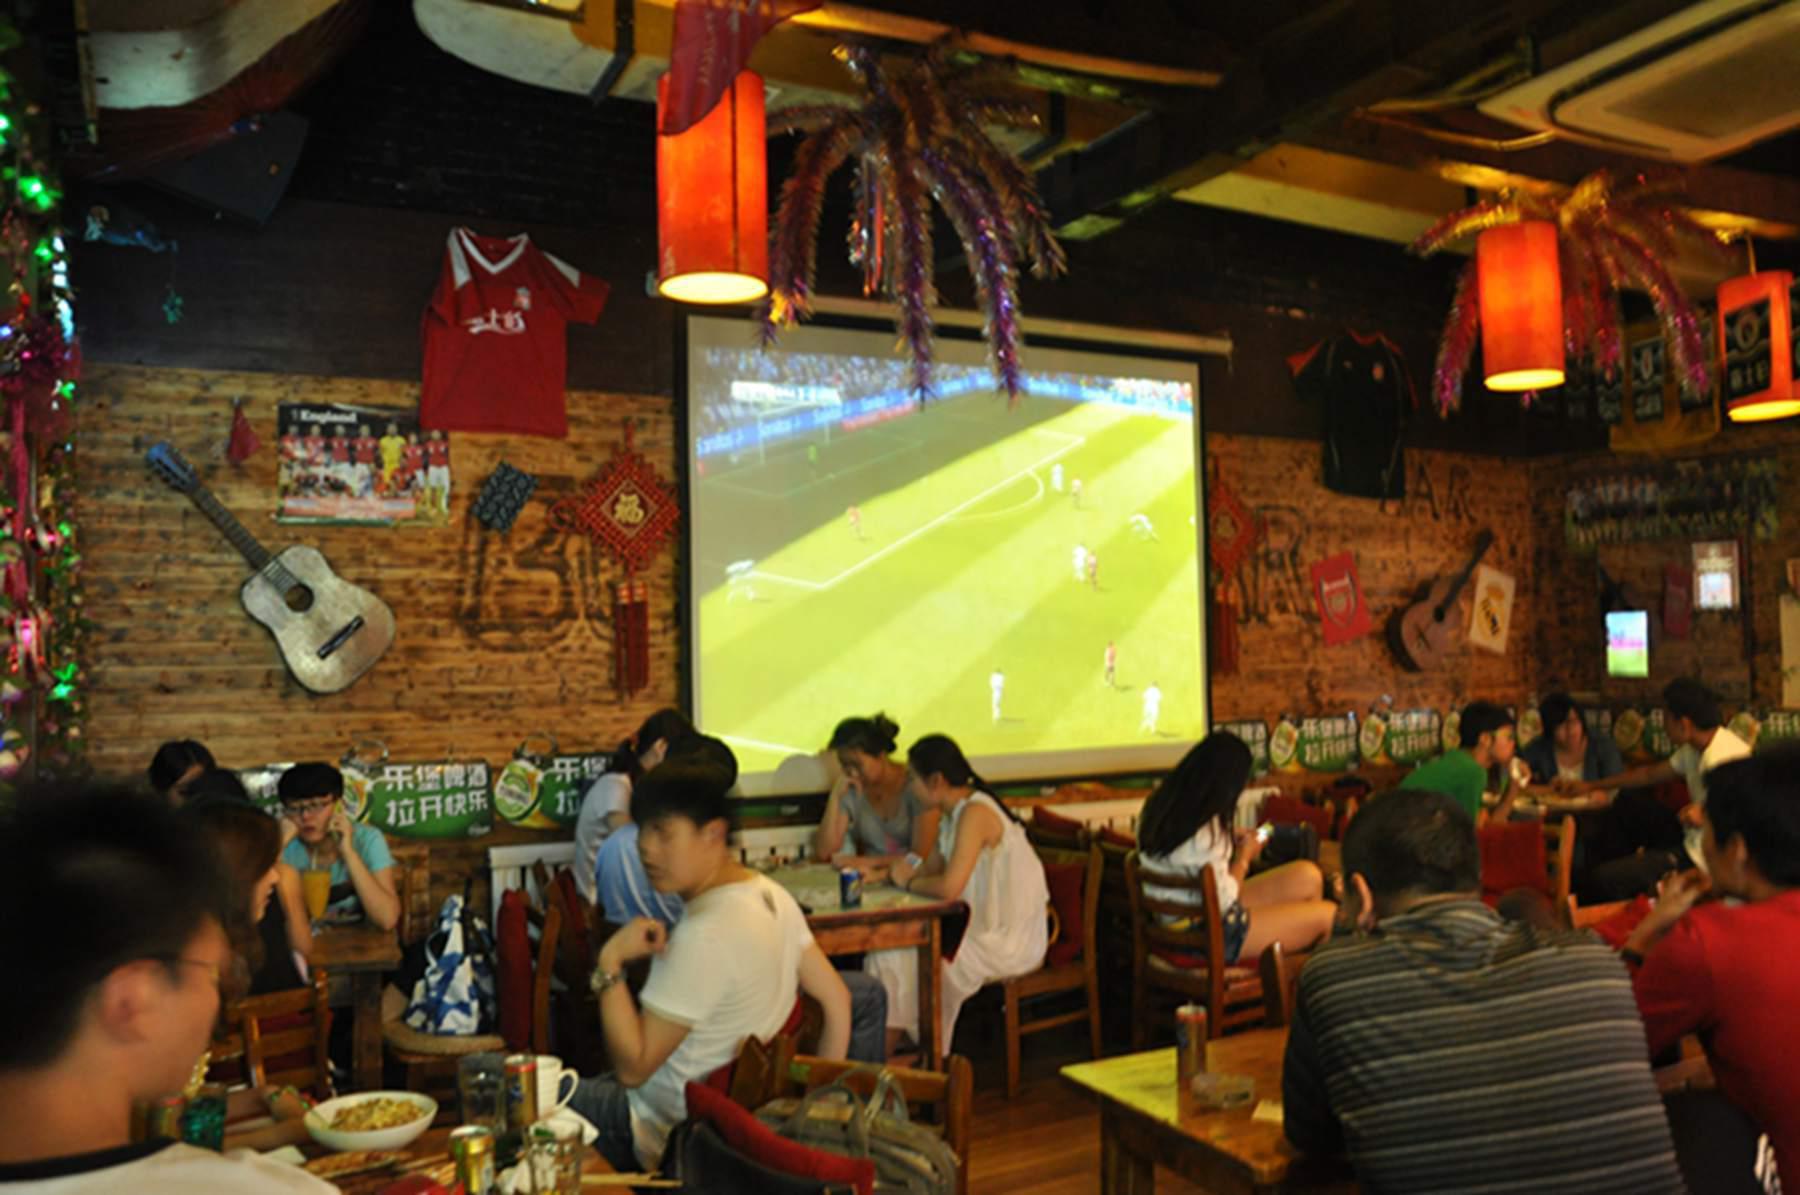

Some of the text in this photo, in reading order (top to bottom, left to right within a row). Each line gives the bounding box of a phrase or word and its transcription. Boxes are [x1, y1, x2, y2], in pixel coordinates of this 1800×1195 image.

[299, 408, 358, 425] England
[384, 762, 488, 793] 乐堡啤酒
[552, 756, 610, 783] 乐堡
[385, 788, 489, 828] 拉开快乐
